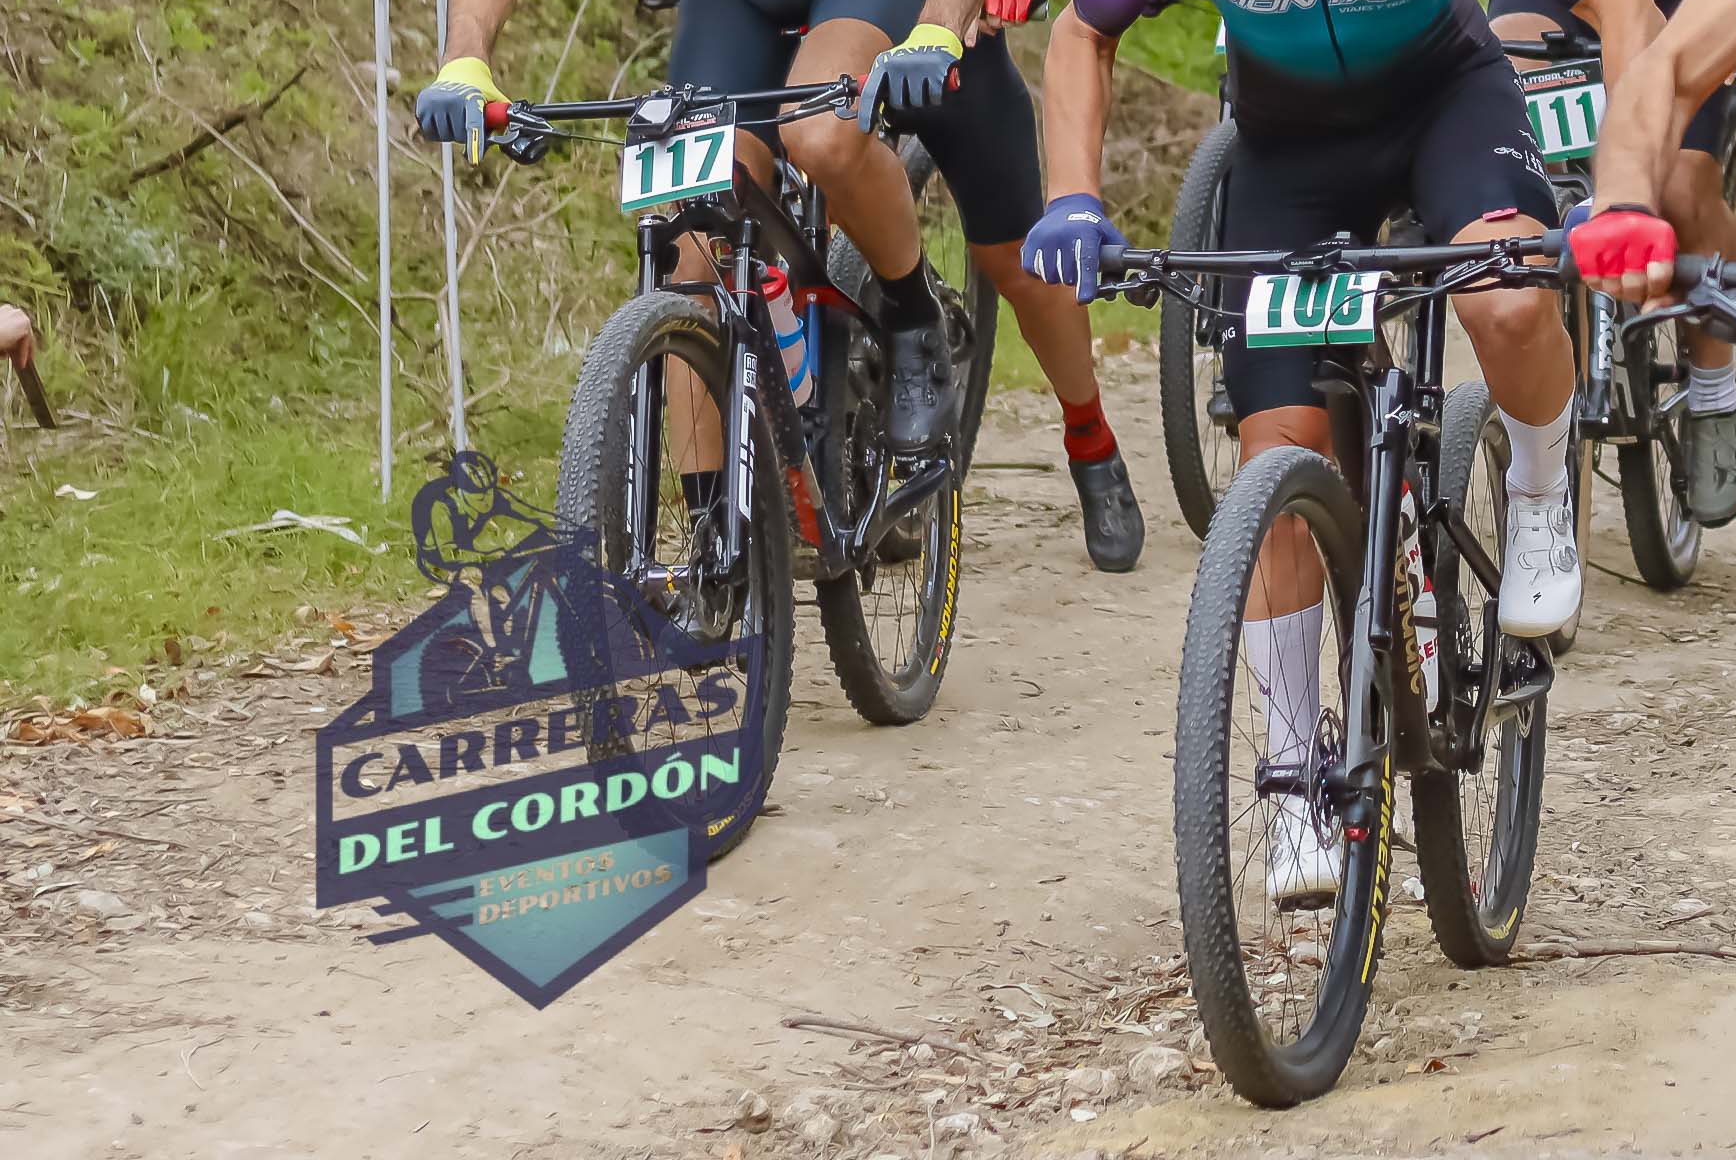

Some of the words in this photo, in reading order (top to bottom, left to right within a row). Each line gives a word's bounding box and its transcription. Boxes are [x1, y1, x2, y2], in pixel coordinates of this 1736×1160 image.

[635, 132, 726, 195] 117
[1266, 273, 1364, 329] 106
[938, 521, 960, 642] SCORPION
[1371, 777, 1392, 926] PIRELLI
